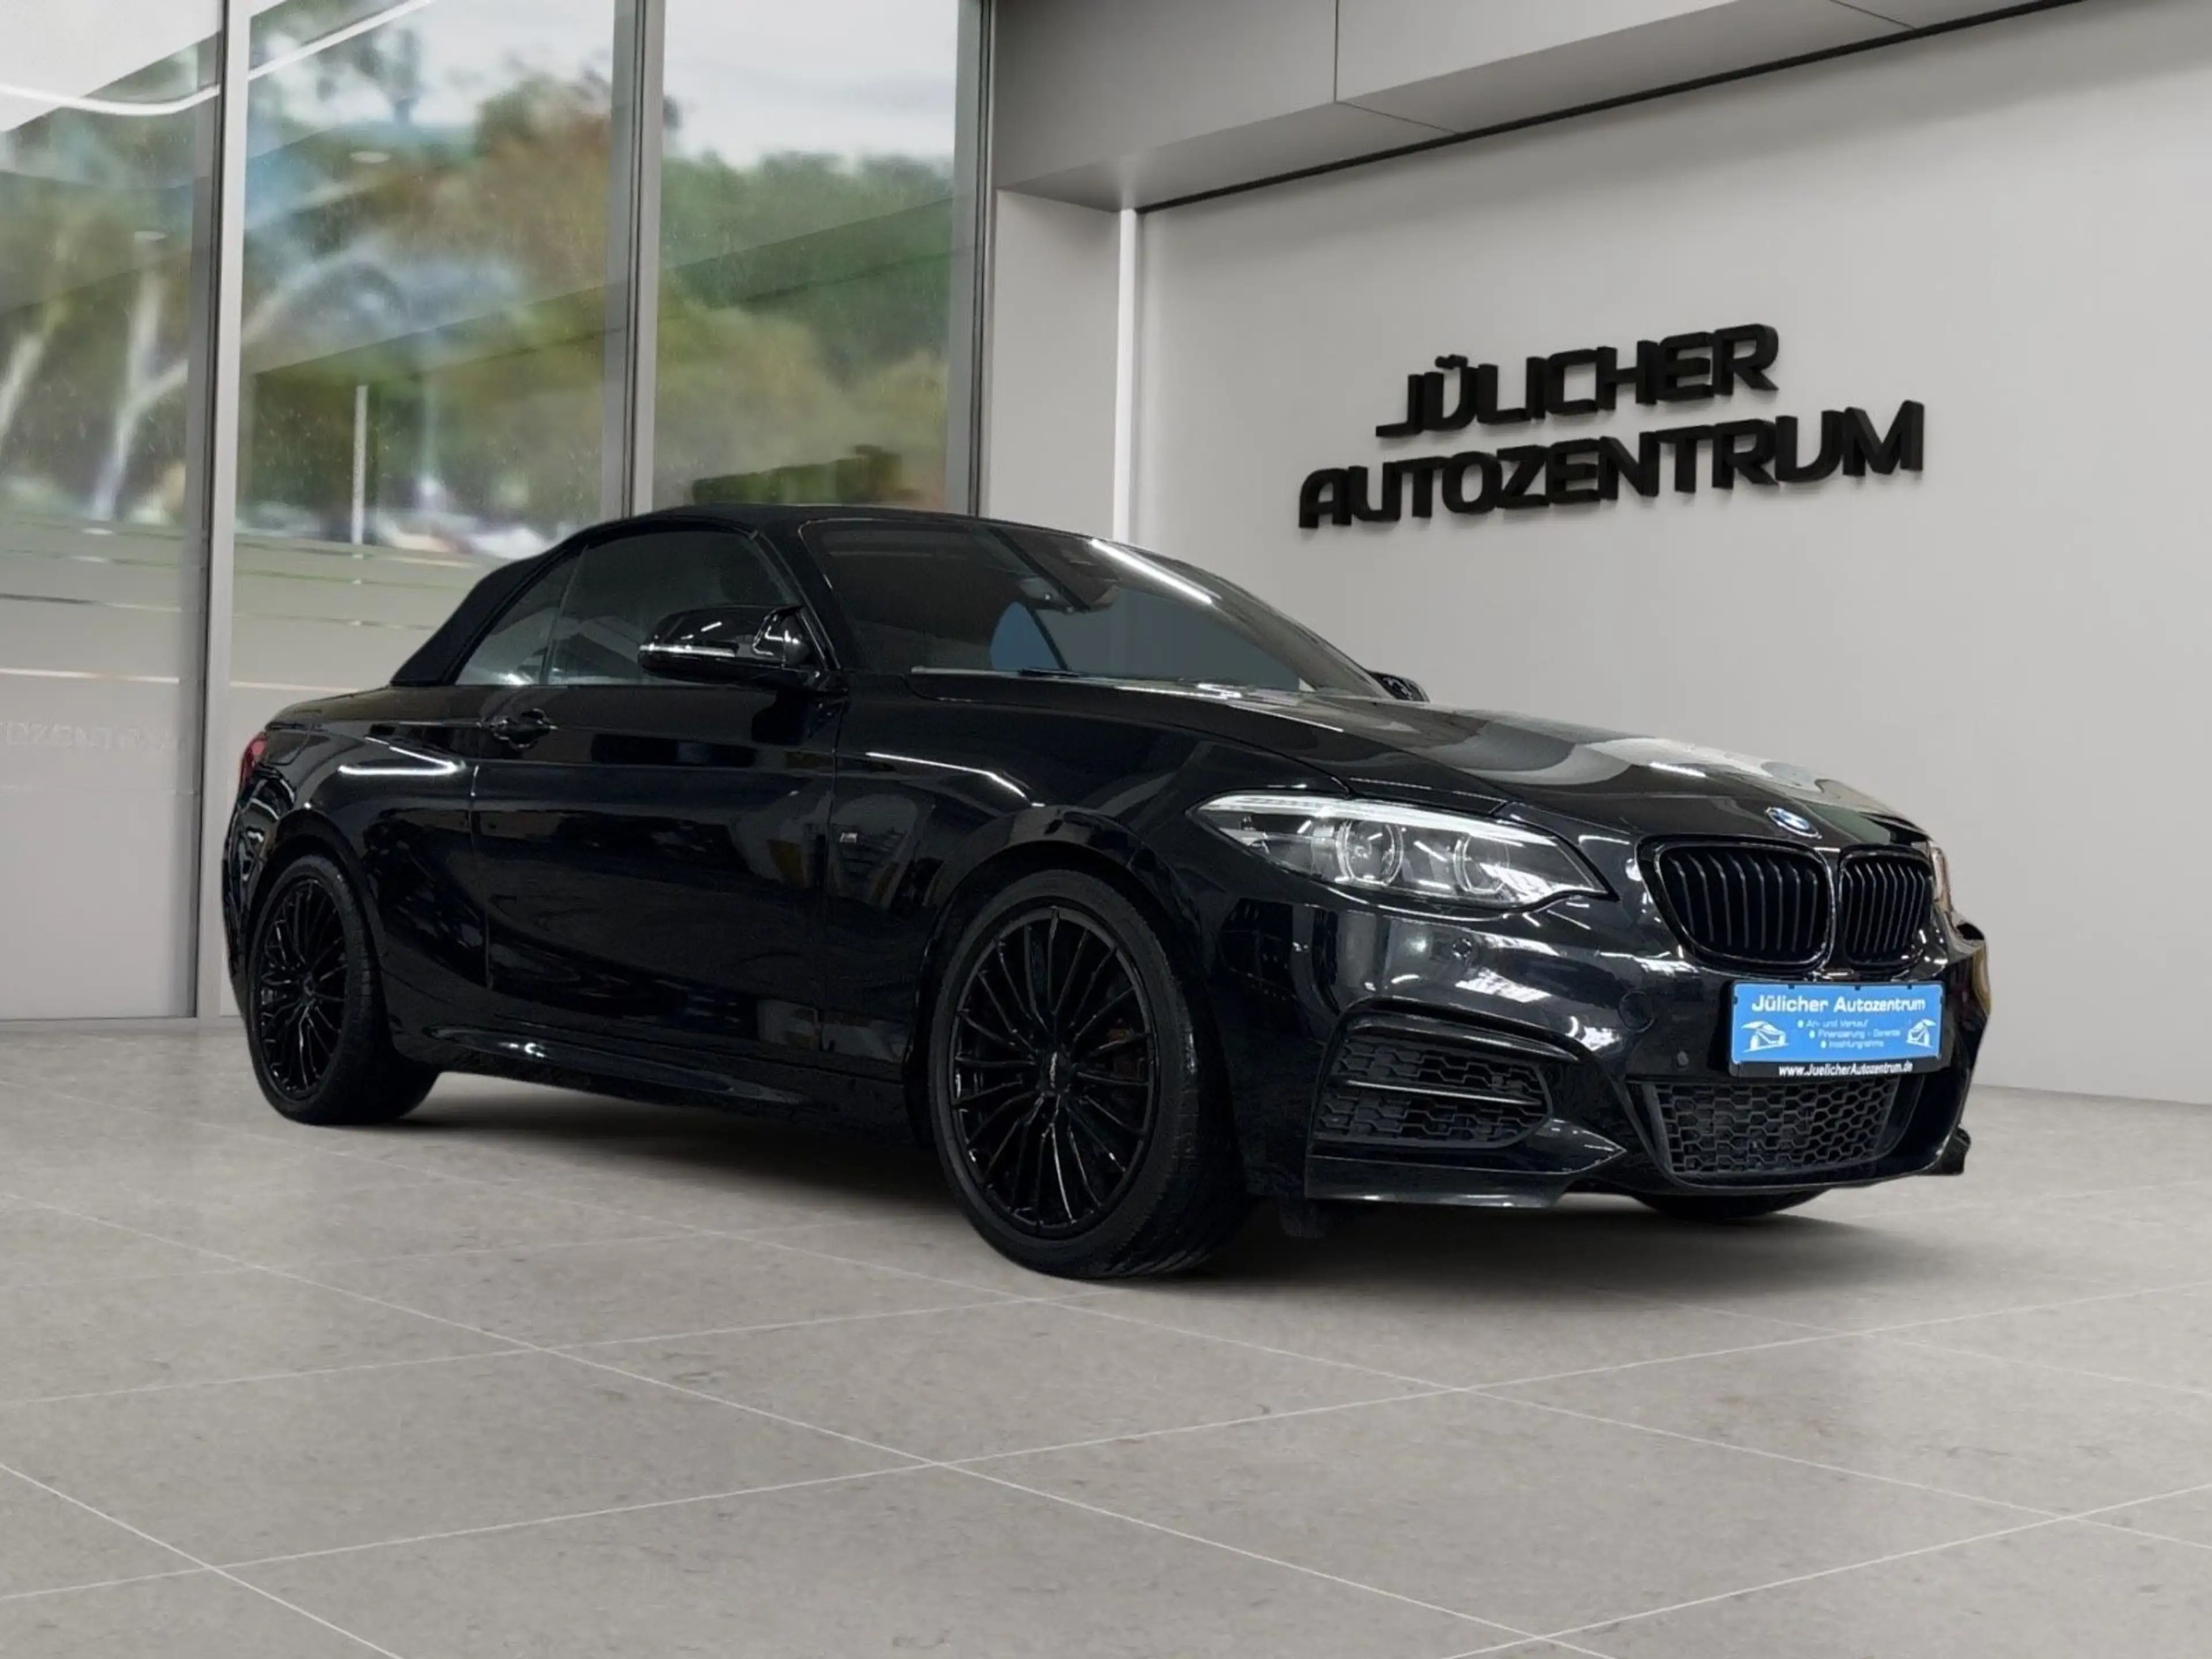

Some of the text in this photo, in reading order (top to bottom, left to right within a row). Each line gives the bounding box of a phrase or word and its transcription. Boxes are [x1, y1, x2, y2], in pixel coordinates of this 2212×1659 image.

[1376, 323, 1779, 437] JÜLICHER
[1298, 400, 1925, 529] AUTOZENTRUM
[1751, 995, 1926, 1013] Jülicher Autozentrum
[1779, 1060, 1913, 1077] www.JuelicherAutozentrum.de
